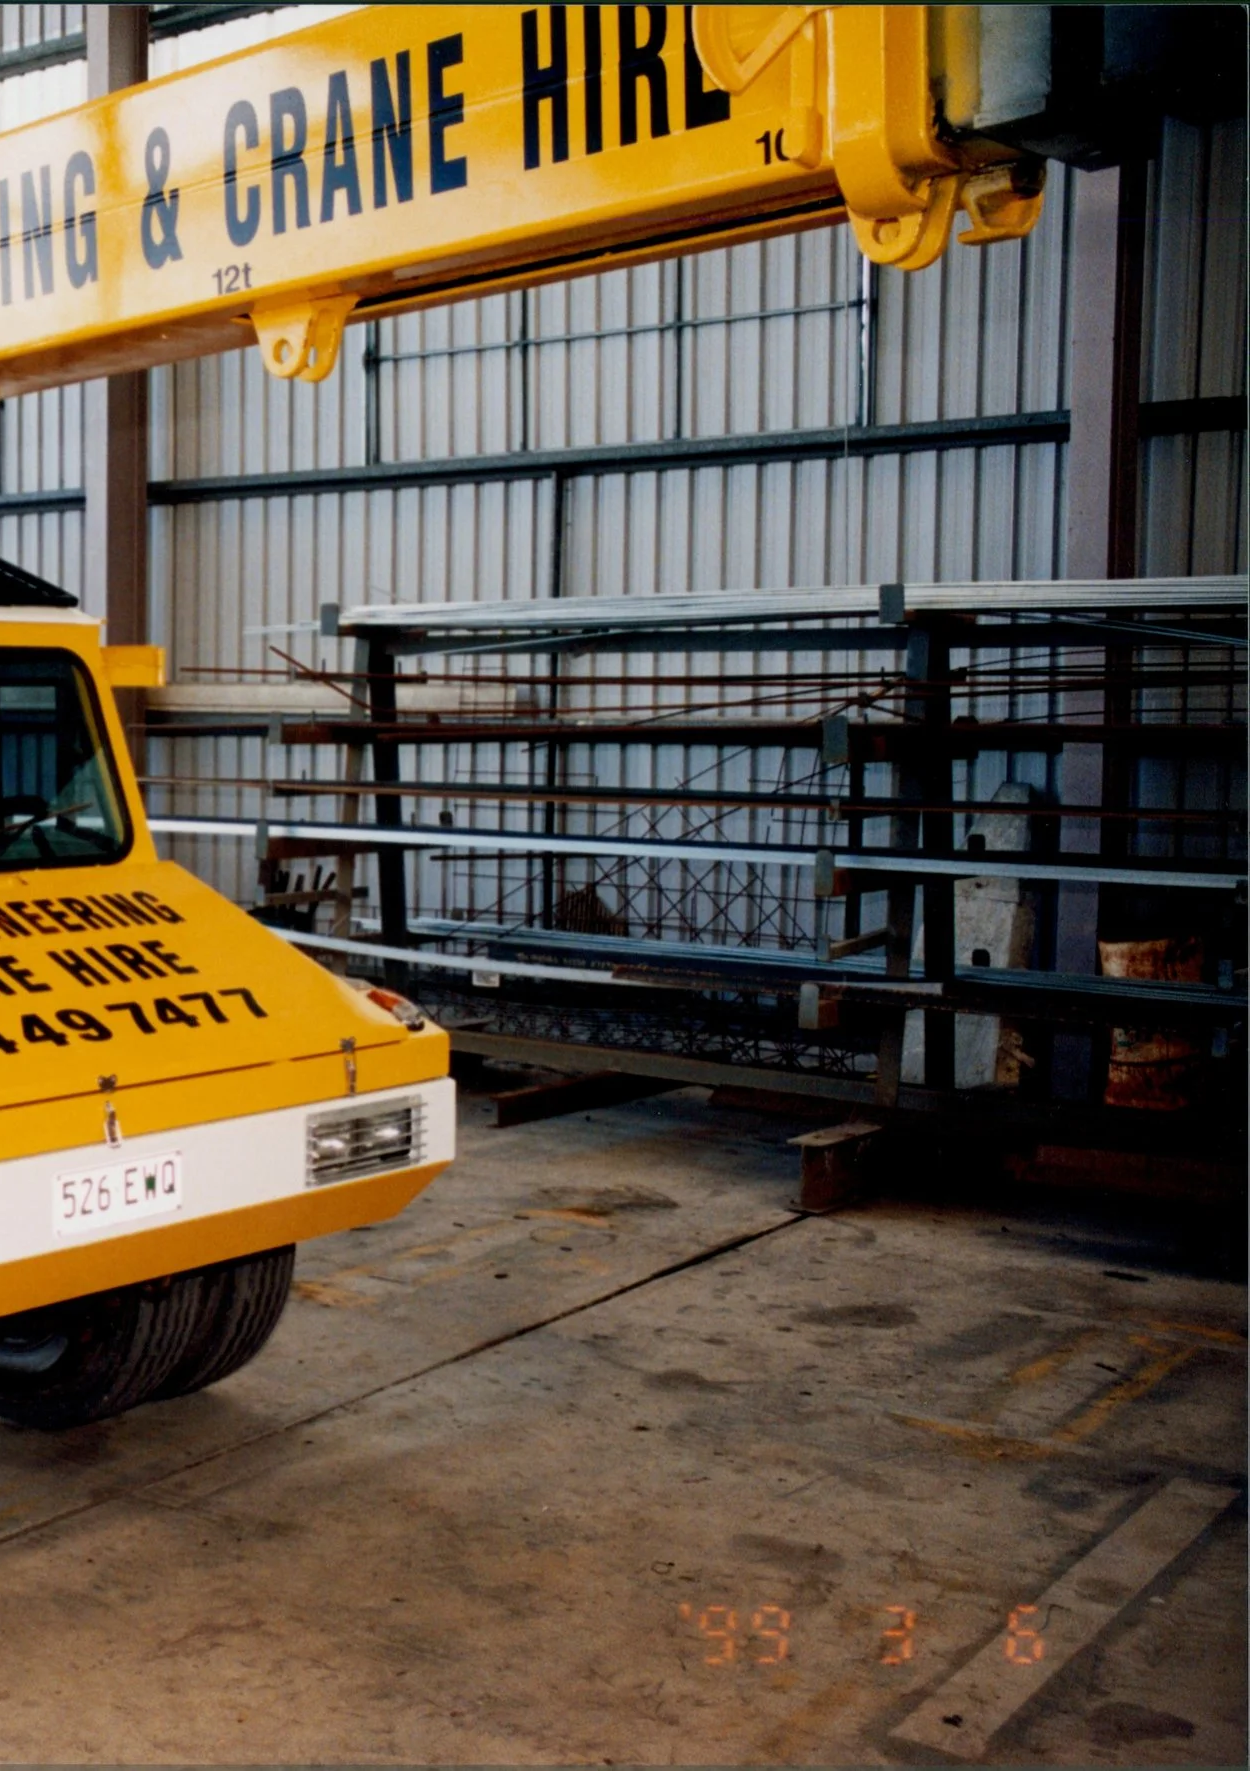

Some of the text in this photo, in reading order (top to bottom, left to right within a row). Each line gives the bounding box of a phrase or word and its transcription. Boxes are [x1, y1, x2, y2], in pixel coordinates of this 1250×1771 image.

[141, 126, 183, 271] &
[223, 32, 469, 248] CRANE
[212, 262, 252, 296] 12t
[47, 939, 200, 988] HIRE
[62, 1159, 176, 1219] 526 EWQ
